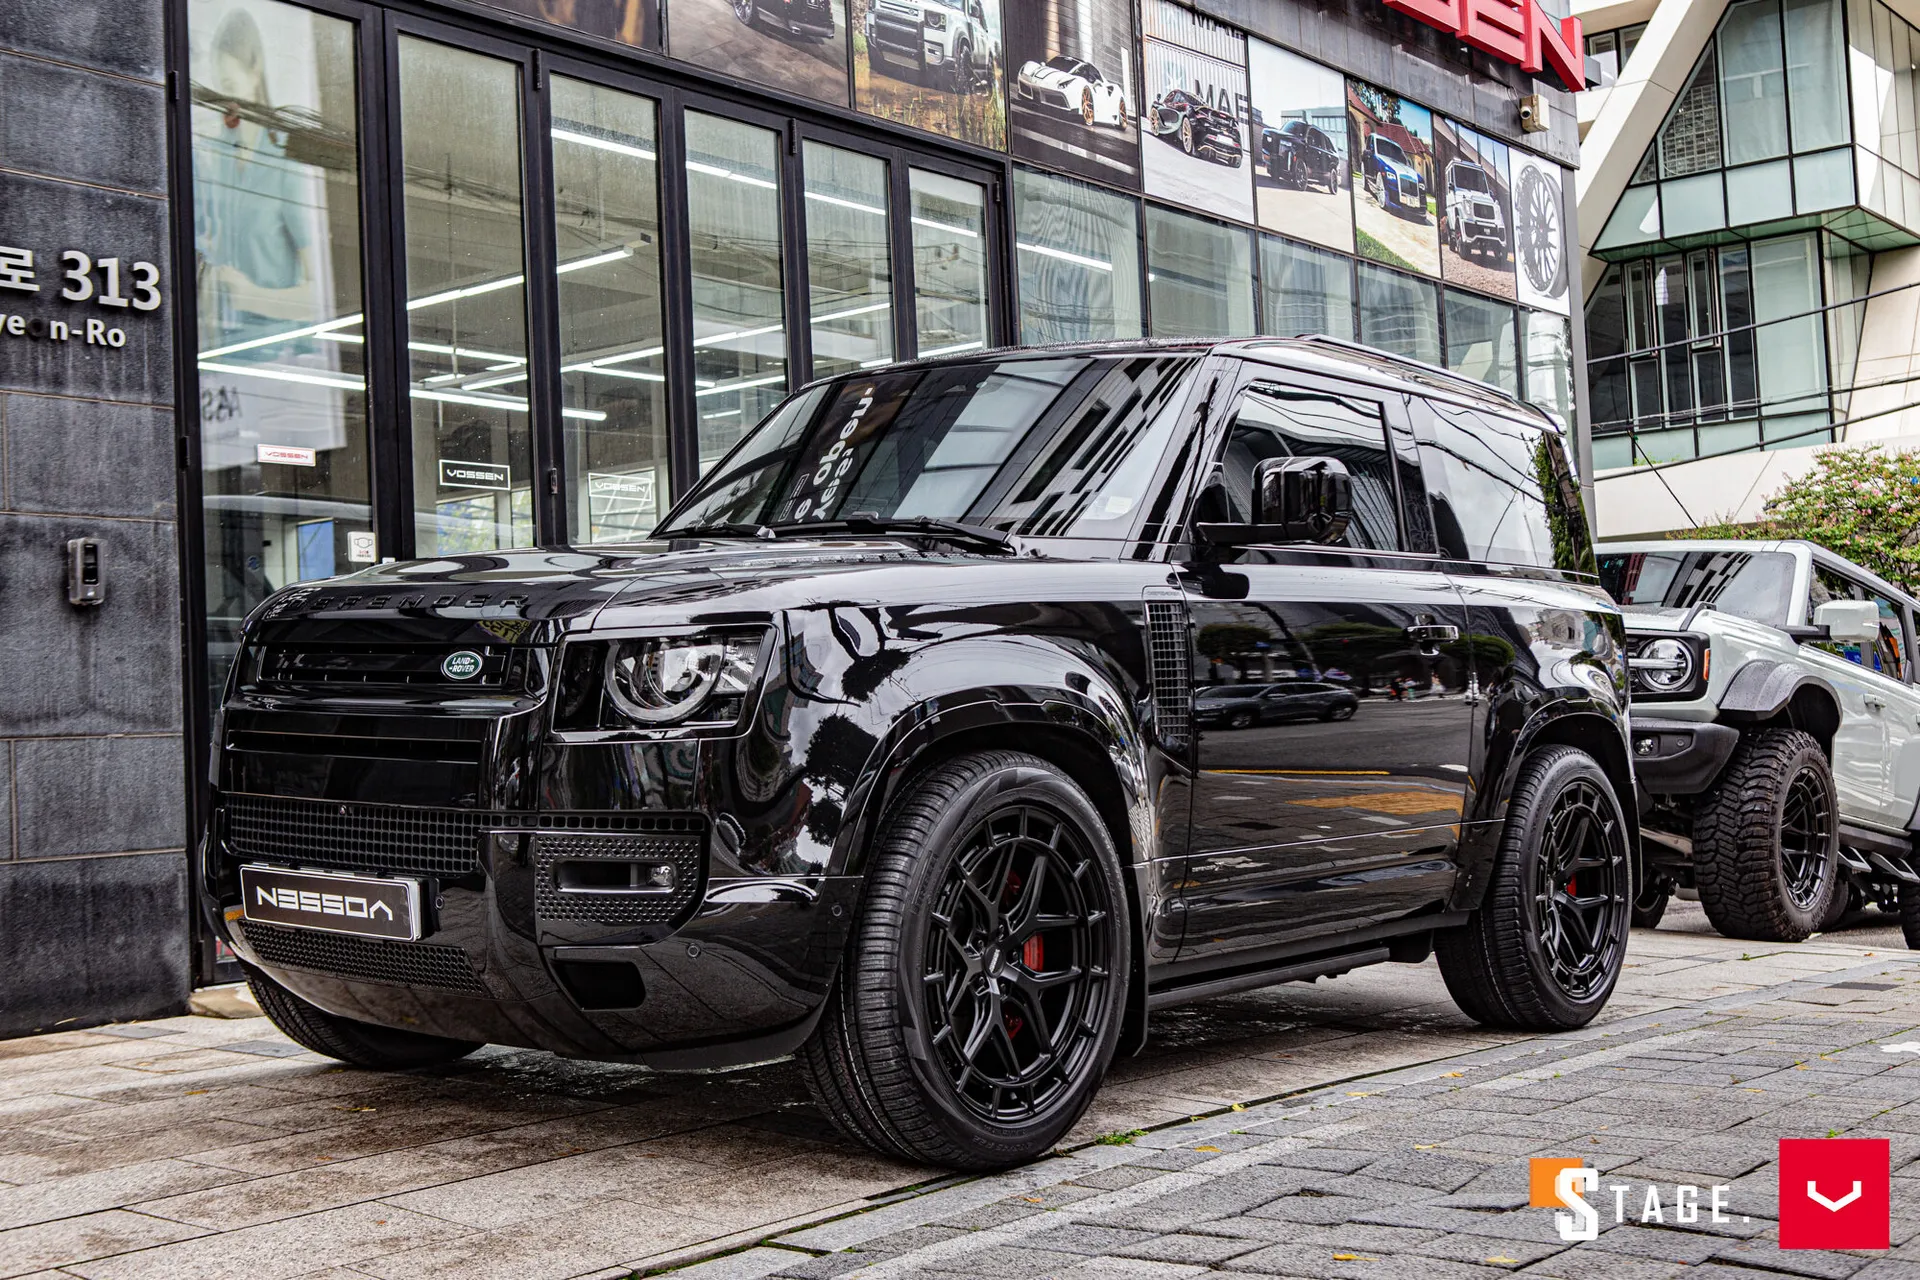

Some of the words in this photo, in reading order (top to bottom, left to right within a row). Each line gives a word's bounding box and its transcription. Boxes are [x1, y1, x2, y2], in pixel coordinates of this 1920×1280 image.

[62, 250, 161, 311] 313
[265, 451, 309, 460] VOSSEN
[446, 469, 504, 481] VOSSEN
[595, 481, 646, 493] VOSSEN
[452, 657, 470, 665] LAND
[452, 665, 475, 673] ROVER
